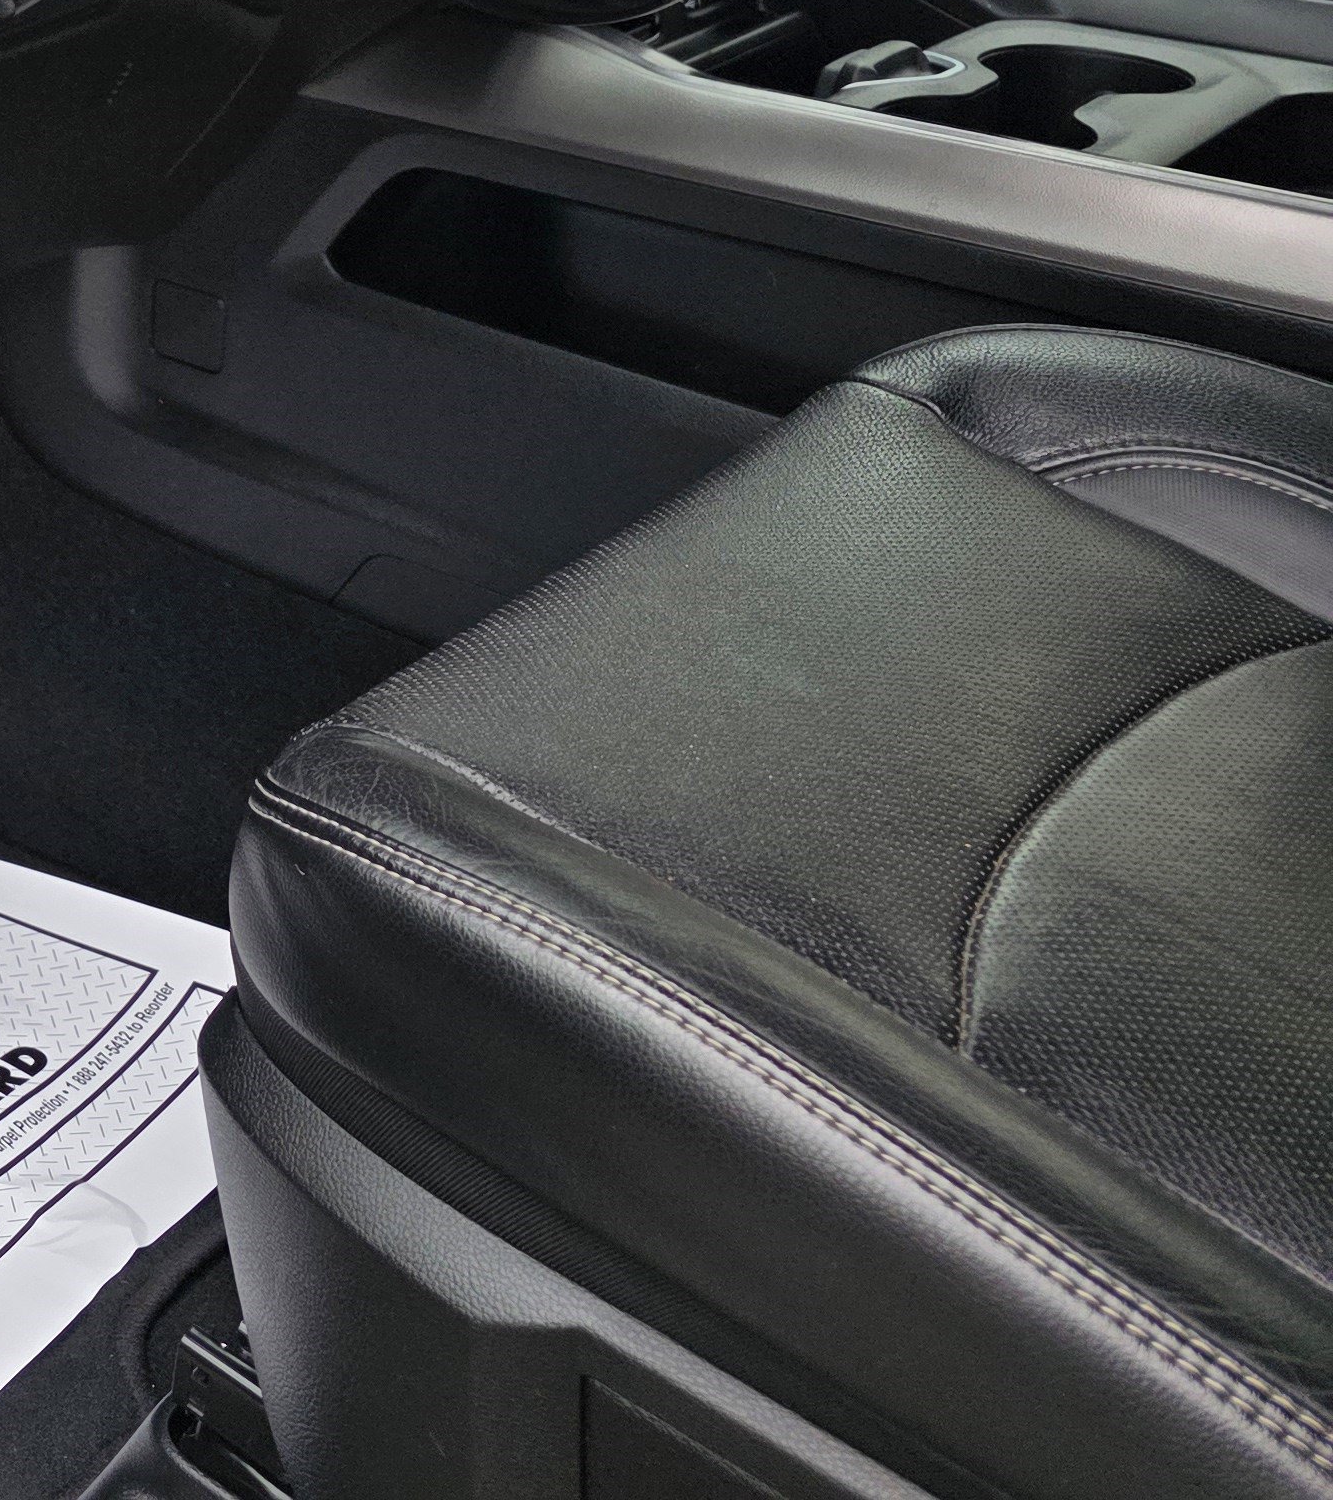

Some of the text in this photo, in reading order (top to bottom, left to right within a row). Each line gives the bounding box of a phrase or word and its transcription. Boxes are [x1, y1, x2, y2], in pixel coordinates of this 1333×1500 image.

[134, 982, 174, 1023] Reorder
[126, 1022, 143, 1034] to
[88, 1030, 134, 1071] 247-5432
[66, 1081, 80, 1091] 1
[72, 1067, 97, 1085] 888
[13, 1094, 68, 1134] Protection
